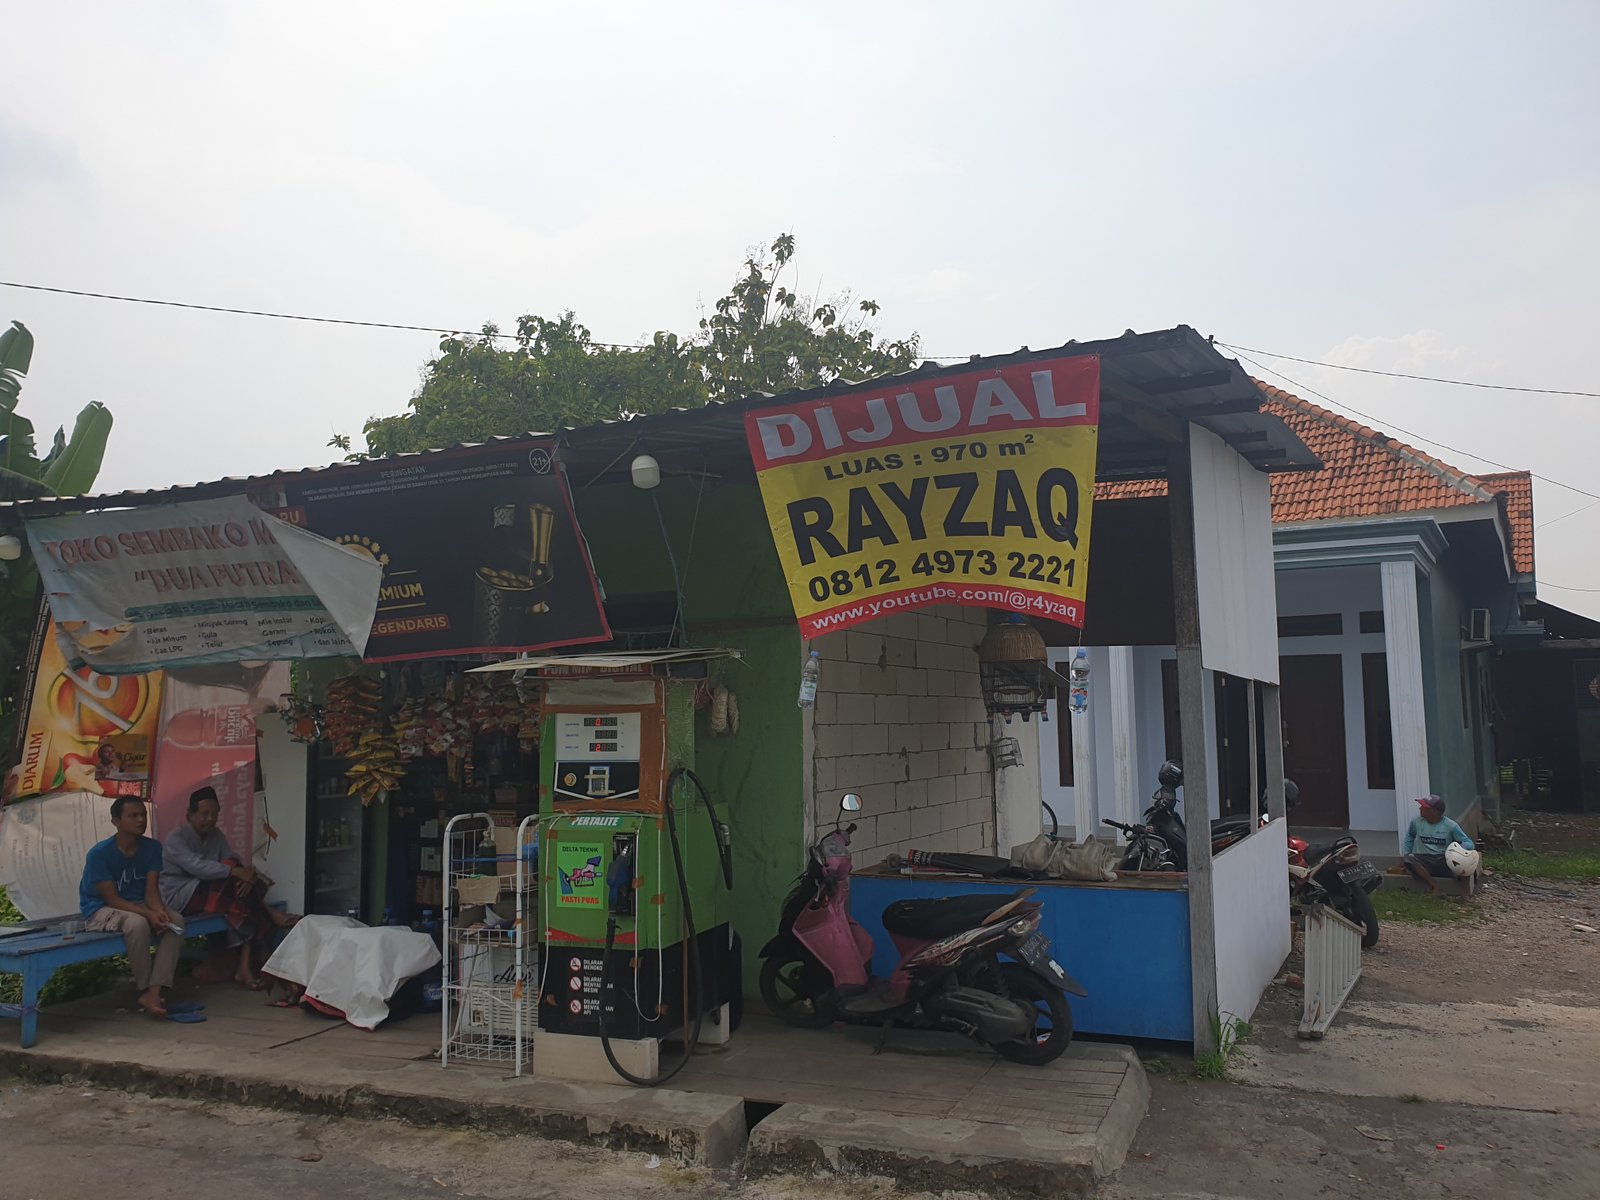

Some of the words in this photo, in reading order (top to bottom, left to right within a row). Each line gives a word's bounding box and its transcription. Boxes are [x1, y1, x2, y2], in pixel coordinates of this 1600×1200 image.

[757, 370, 1086, 460] DIJUAL
[824, 453, 904, 480] LUAS
[931, 442, 988, 464] 970
[786, 467, 1079, 566] RAYZAQ
[41, 535, 119, 566] TOKO
[118, 521, 245, 557] SEMBAKO
[210, 560, 302, 589] PUTRA
[378, 582, 424, 602] MIUM
[808, 558, 900, 602] 0812
[912, 549, 998, 577] 4973
[1007, 551, 1076, 588] 2221
[371, 616, 447, 635] EGENDARIS
[813, 586, 1077, 631] www.youtube.com/@r4yzaq
[22, 732, 44, 791] DJARUM
[561, 896, 580, 904] PASTI
[581, 896, 600, 904] PUAS
